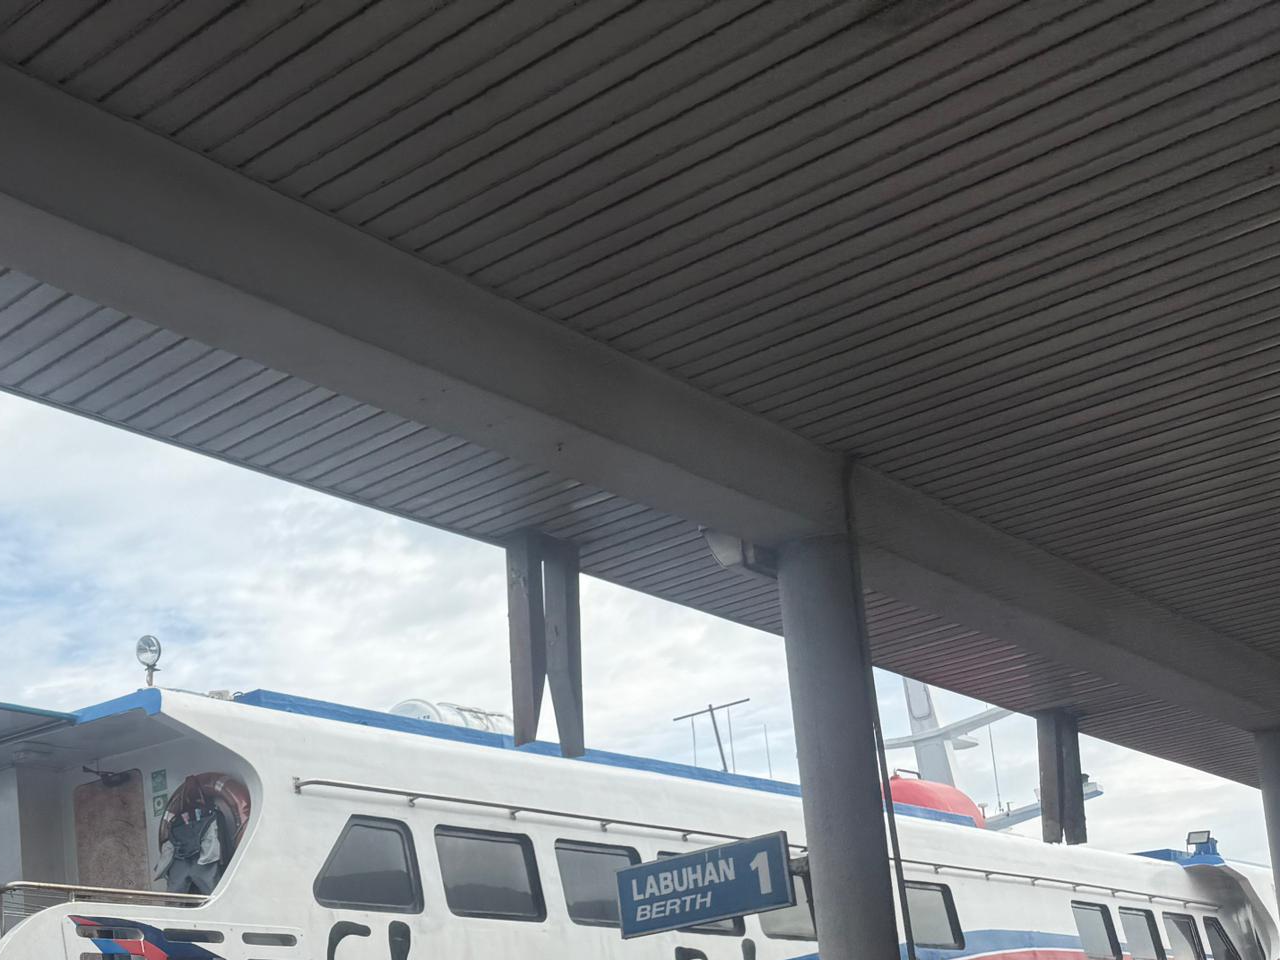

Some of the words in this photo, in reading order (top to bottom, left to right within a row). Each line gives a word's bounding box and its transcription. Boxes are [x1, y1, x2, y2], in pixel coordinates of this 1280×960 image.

[631, 857, 736, 901] LABUHAN
[749, 851, 772, 895] 1
[636, 891, 712, 922] BERTH
